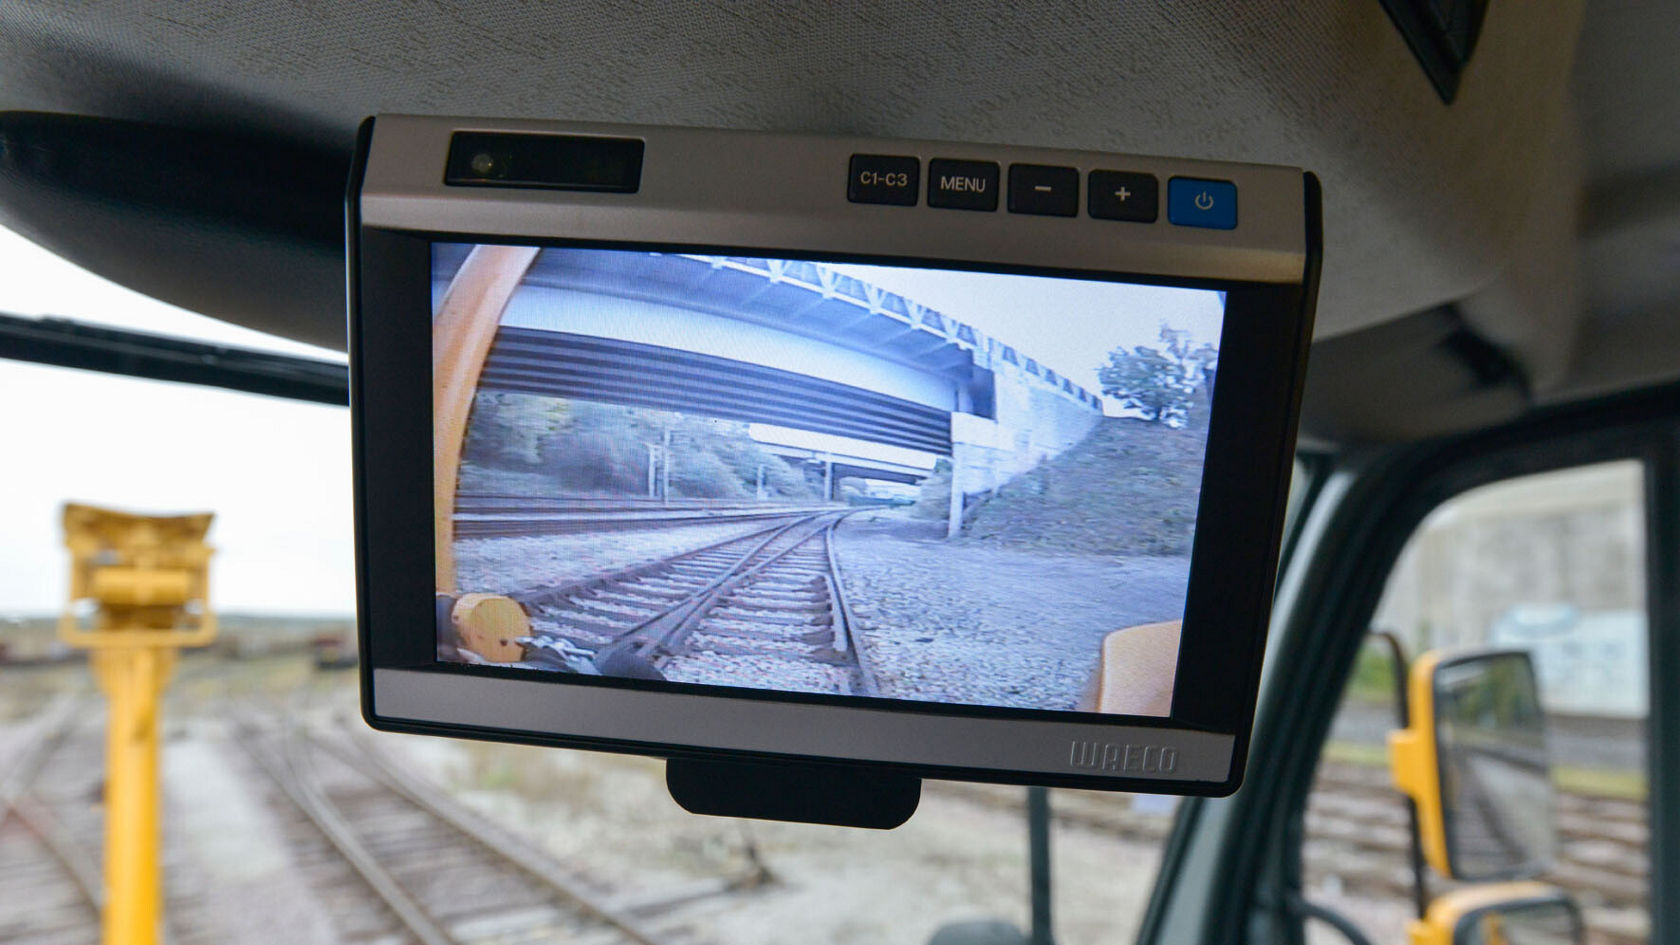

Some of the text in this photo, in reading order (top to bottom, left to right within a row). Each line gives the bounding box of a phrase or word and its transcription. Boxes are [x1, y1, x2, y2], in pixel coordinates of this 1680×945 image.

[860, 171, 908, 188] C1-C3
[940, 174, 986, 193] MENU
[1069, 740, 1178, 773] WAECO
